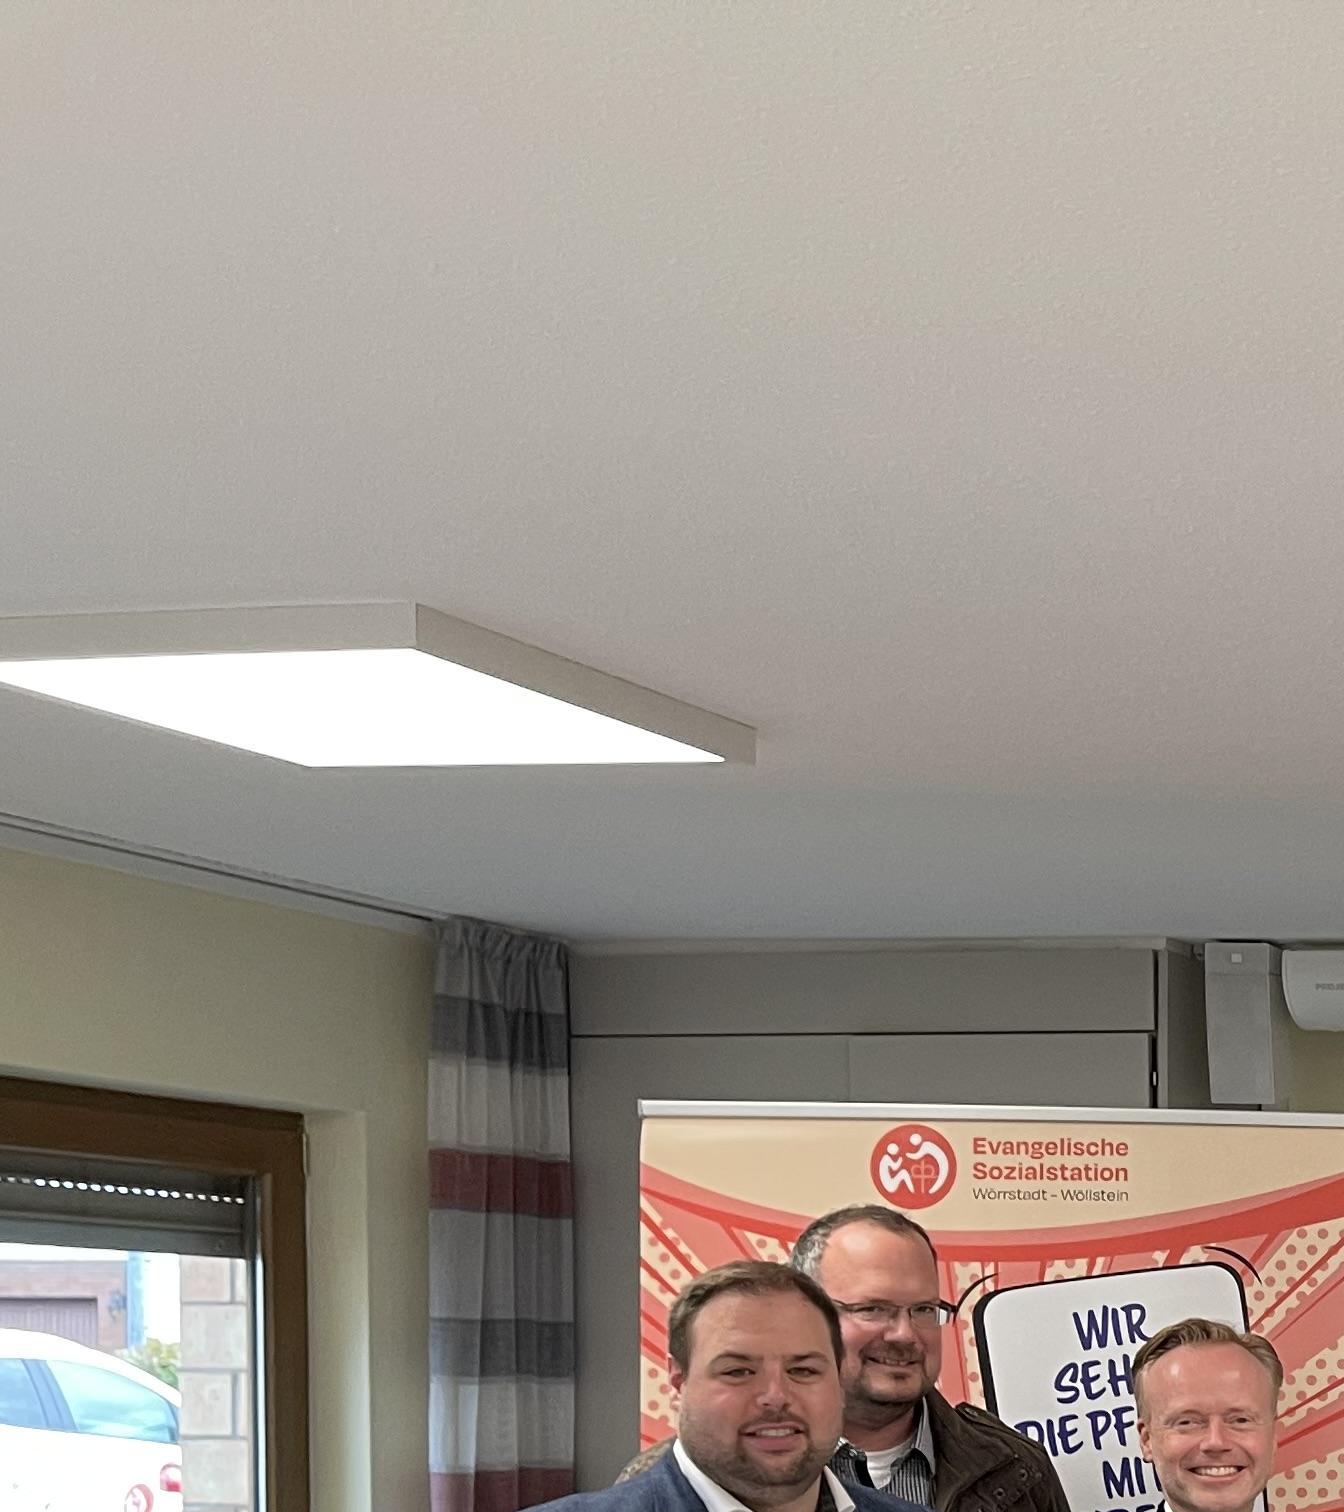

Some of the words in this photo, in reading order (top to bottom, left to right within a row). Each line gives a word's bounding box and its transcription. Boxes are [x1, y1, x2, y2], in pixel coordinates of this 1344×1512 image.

[972, 1137, 1130, 1159] Evangelische
[972, 1162, 1129, 1182] Sozialstation
[972, 1187, 1048, 1201] Wörrstadt
[1060, 1189, 1129, 1202] Wöllstein
[1072, 1303, 1153, 1351] WIR
[1054, 1353, 1135, 1404] SEH
[1085, 1406, 1135, 1451] PF
[1102, 1457, 1163, 1500] MI
